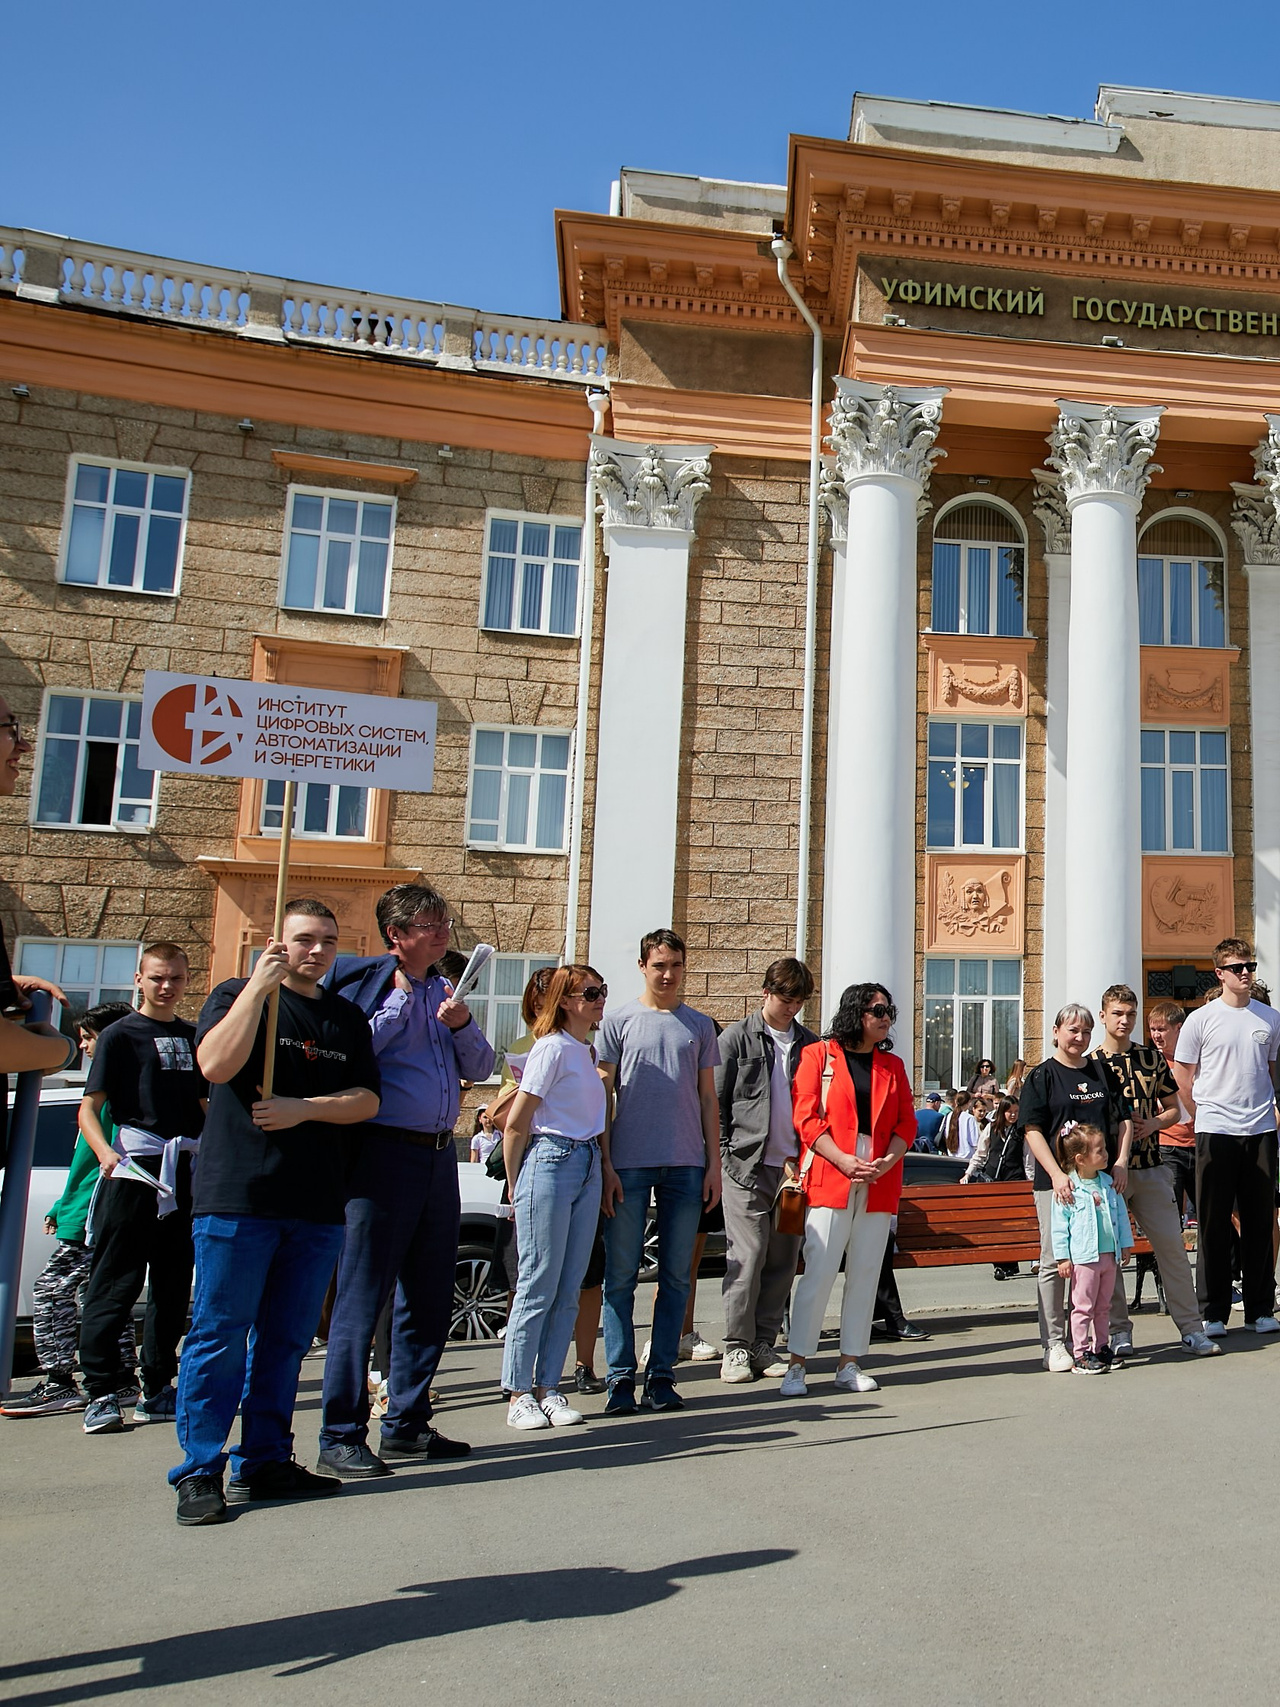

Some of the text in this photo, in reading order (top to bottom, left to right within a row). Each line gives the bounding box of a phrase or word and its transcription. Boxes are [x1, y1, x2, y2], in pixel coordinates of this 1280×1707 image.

[881, 277, 1044, 316] УФИМСКИЙ
[258, 697, 347, 719] ИНСТИТУТ
[257, 715, 430, 746] ЦИФРОВЫХ СИСТЕМ,
[255, 733, 402, 758] АВТОМАТИЗАЦИИ
[254, 751, 375, 773] И ЭНЕРГЕТИКИ
